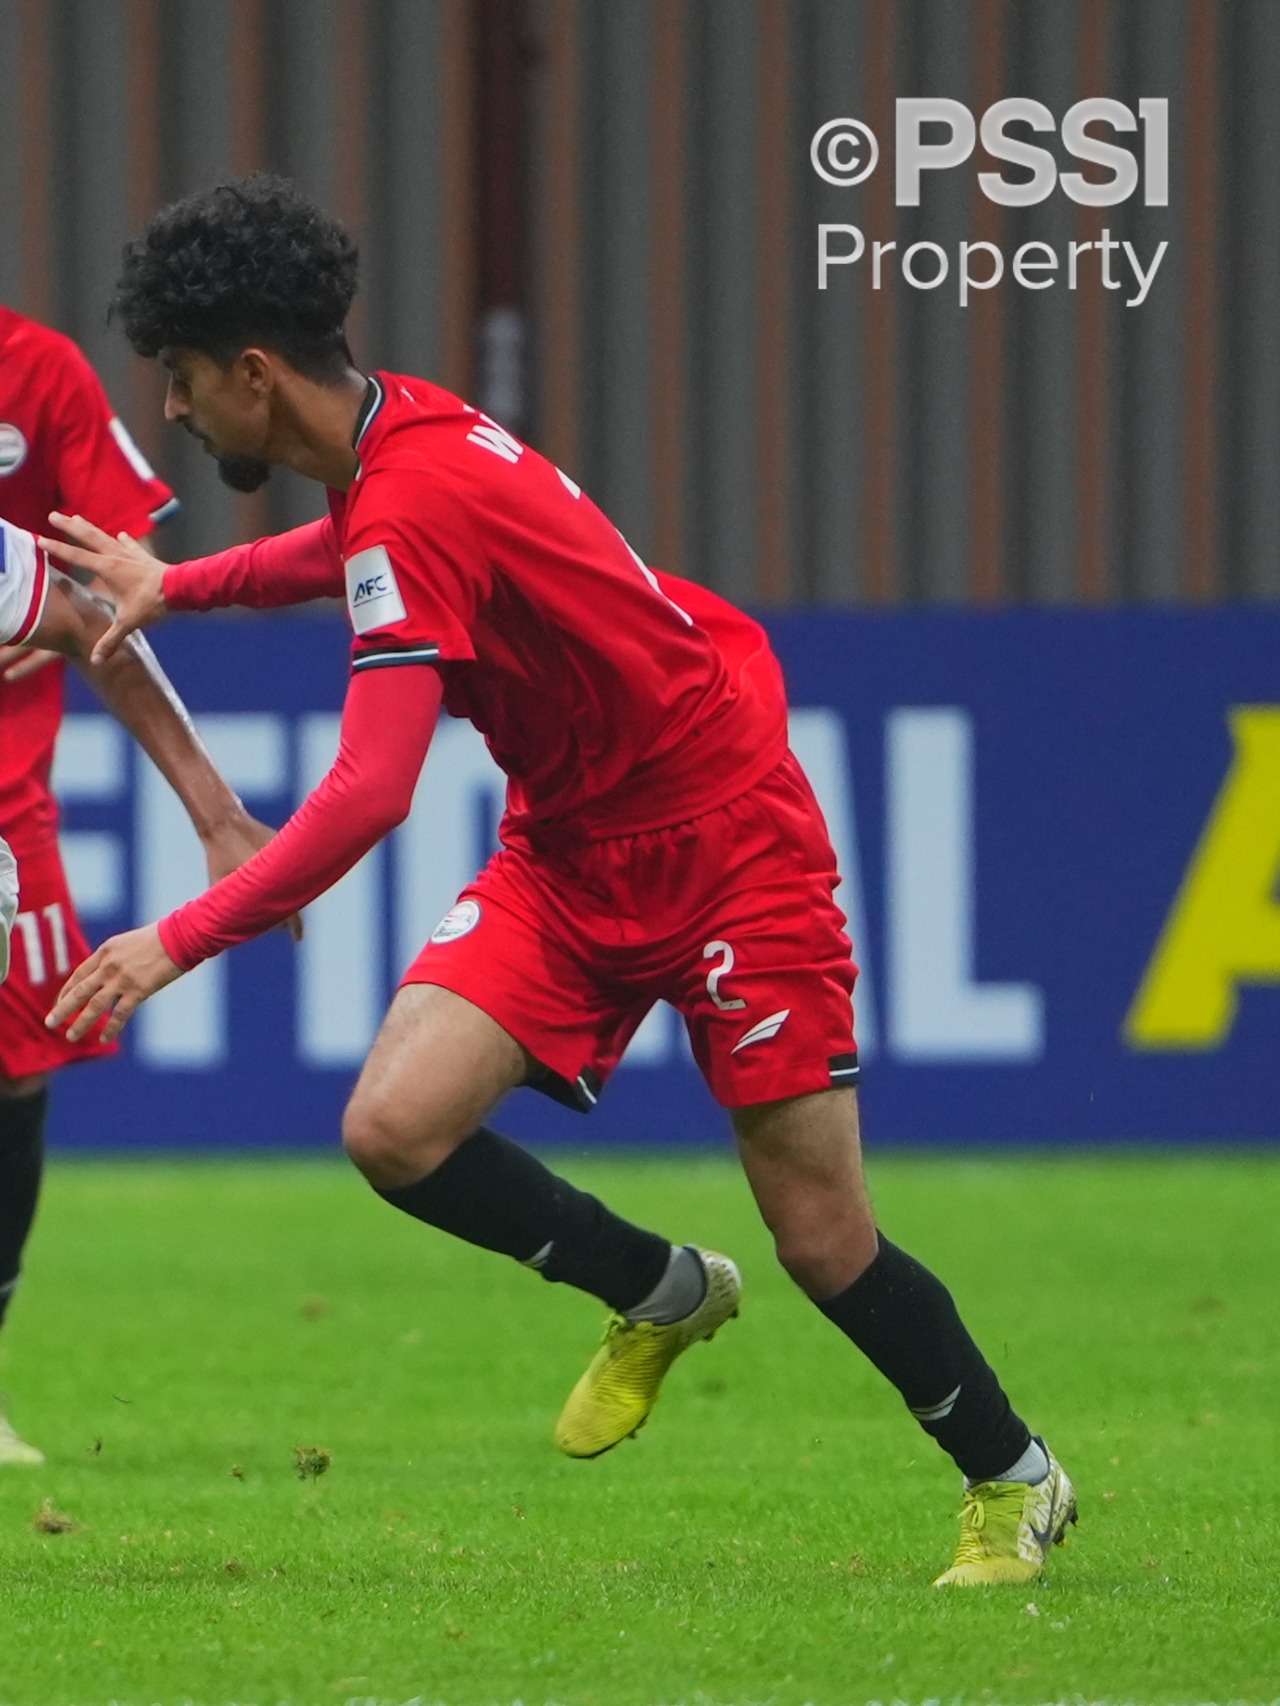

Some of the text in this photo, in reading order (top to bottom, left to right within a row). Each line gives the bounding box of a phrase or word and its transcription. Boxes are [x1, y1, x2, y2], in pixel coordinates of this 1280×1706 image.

[353, 574, 387, 602] AFC
[14, 902, 71, 986] 11
[703, 940, 746, 1011] 2
